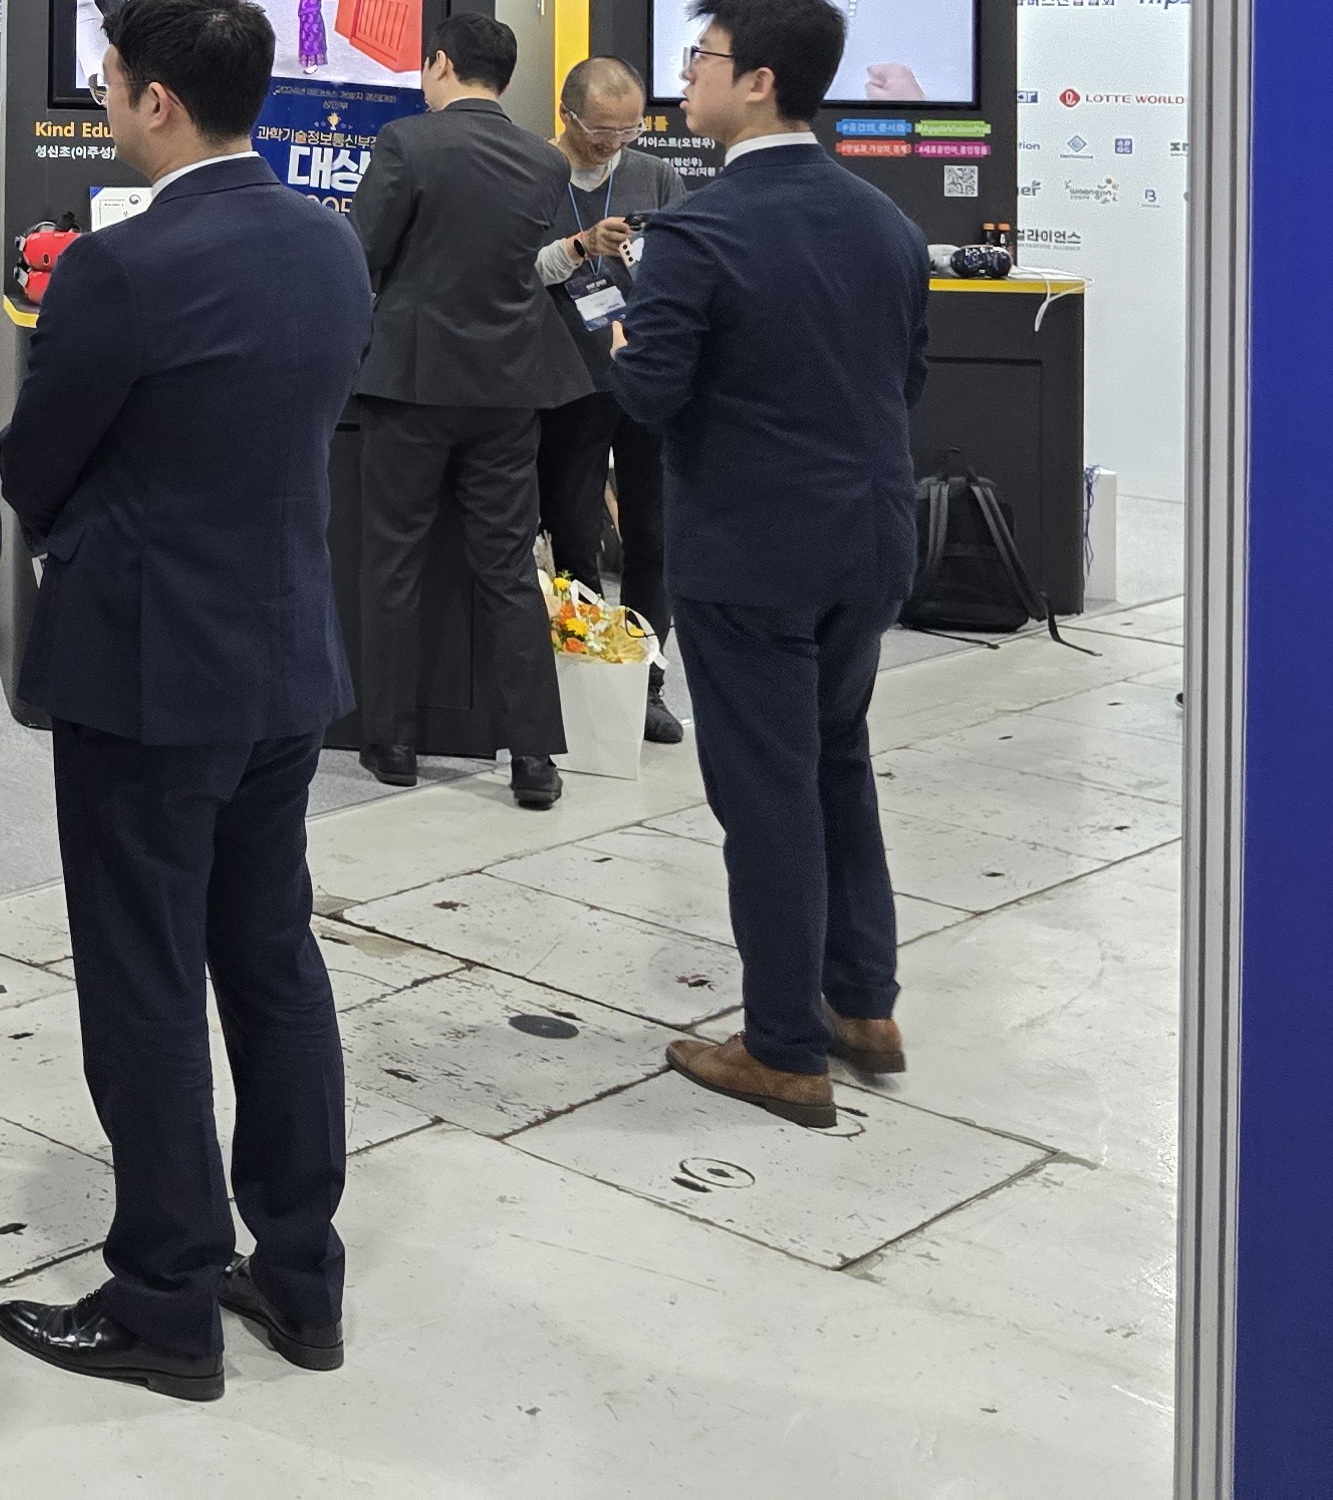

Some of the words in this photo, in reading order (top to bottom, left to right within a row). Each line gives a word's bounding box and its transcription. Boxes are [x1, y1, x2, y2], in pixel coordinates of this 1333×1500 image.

[1085, 94, 1131, 104] LOTTE
[1136, 95, 1184, 104] WORLD
[35, 122, 75, 137] Kind
[288, 145, 371, 192] 대상
